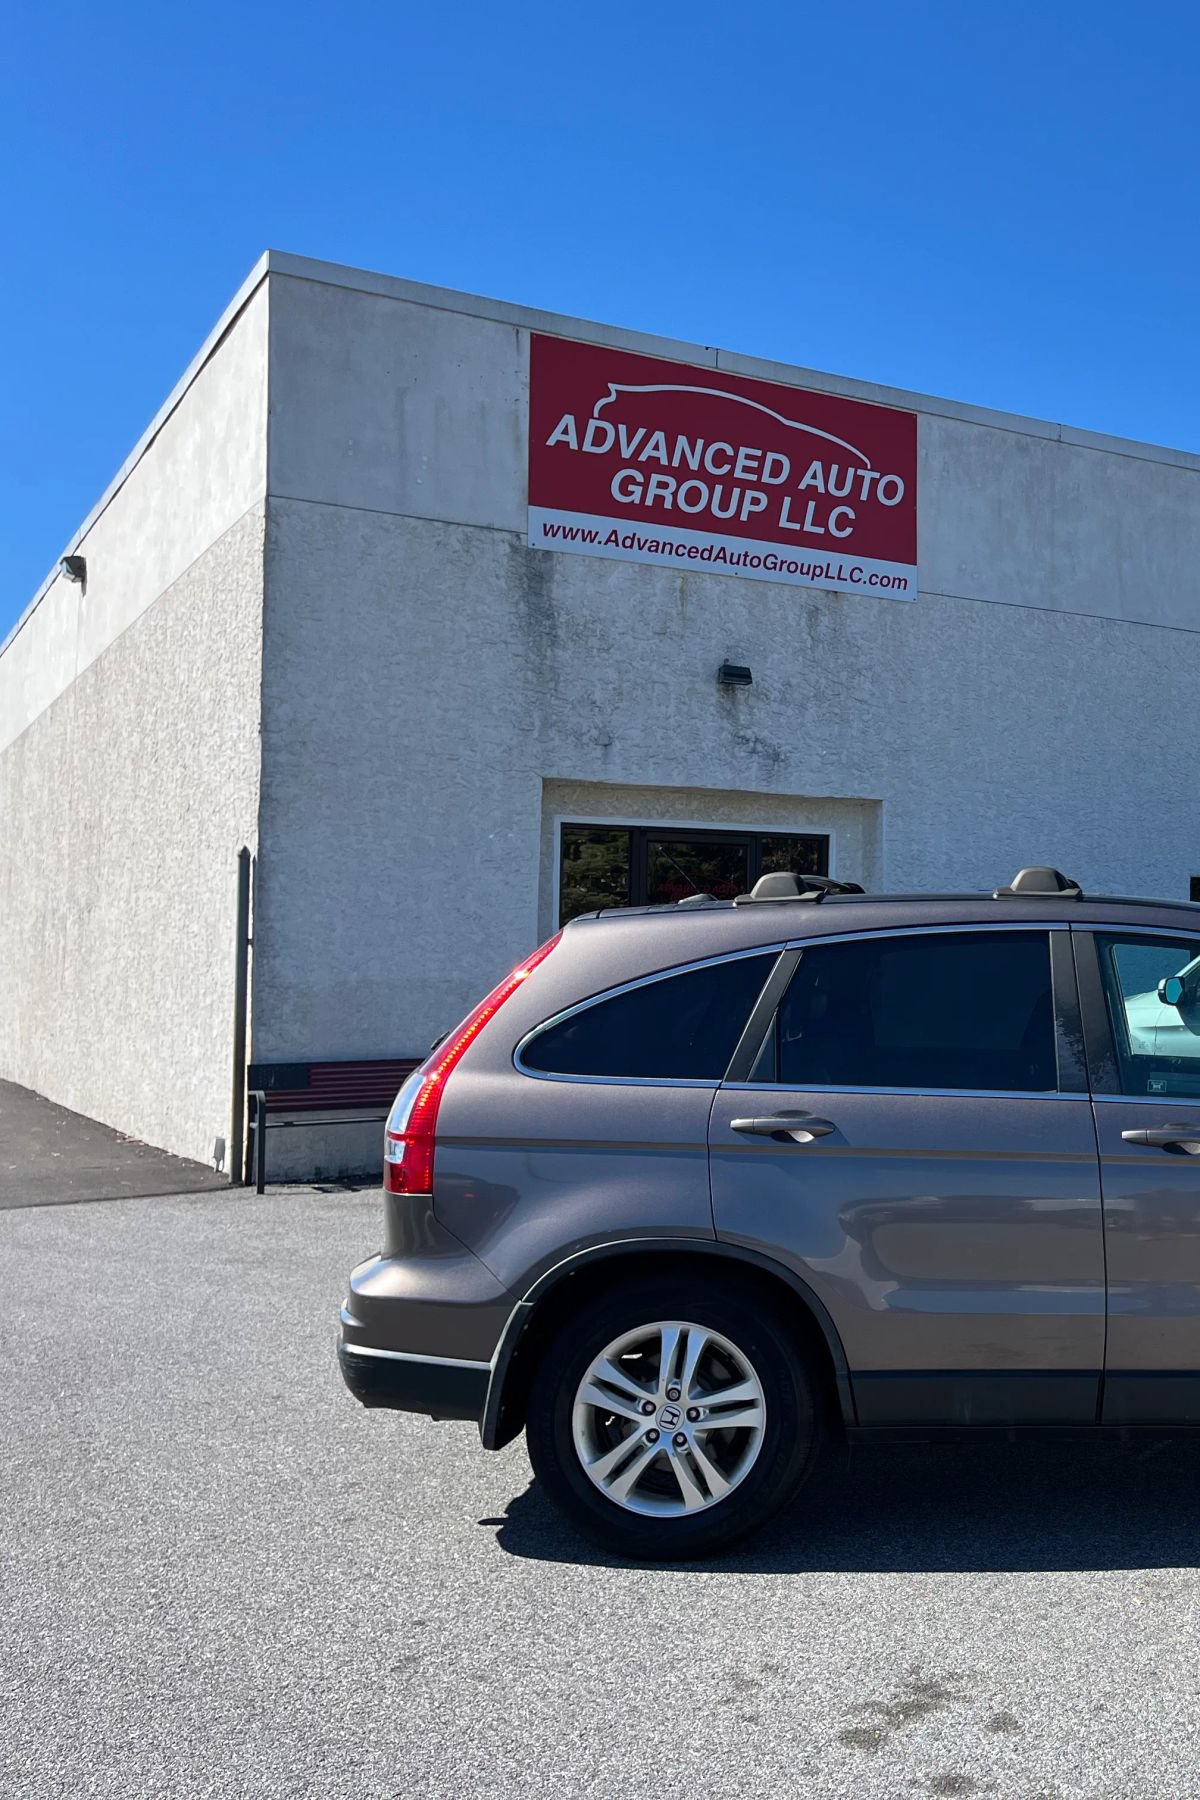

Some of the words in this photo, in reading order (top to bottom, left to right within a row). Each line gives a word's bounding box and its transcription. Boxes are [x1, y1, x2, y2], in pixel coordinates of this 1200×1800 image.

[546, 415, 790, 485] ADVANCED
[799, 460, 905, 506] AUTO
[610, 468, 768, 521] GROUP
[779, 497, 857, 538] LLC
[542, 521, 909, 590] www.AdvancedAutoGroupLLC.com
